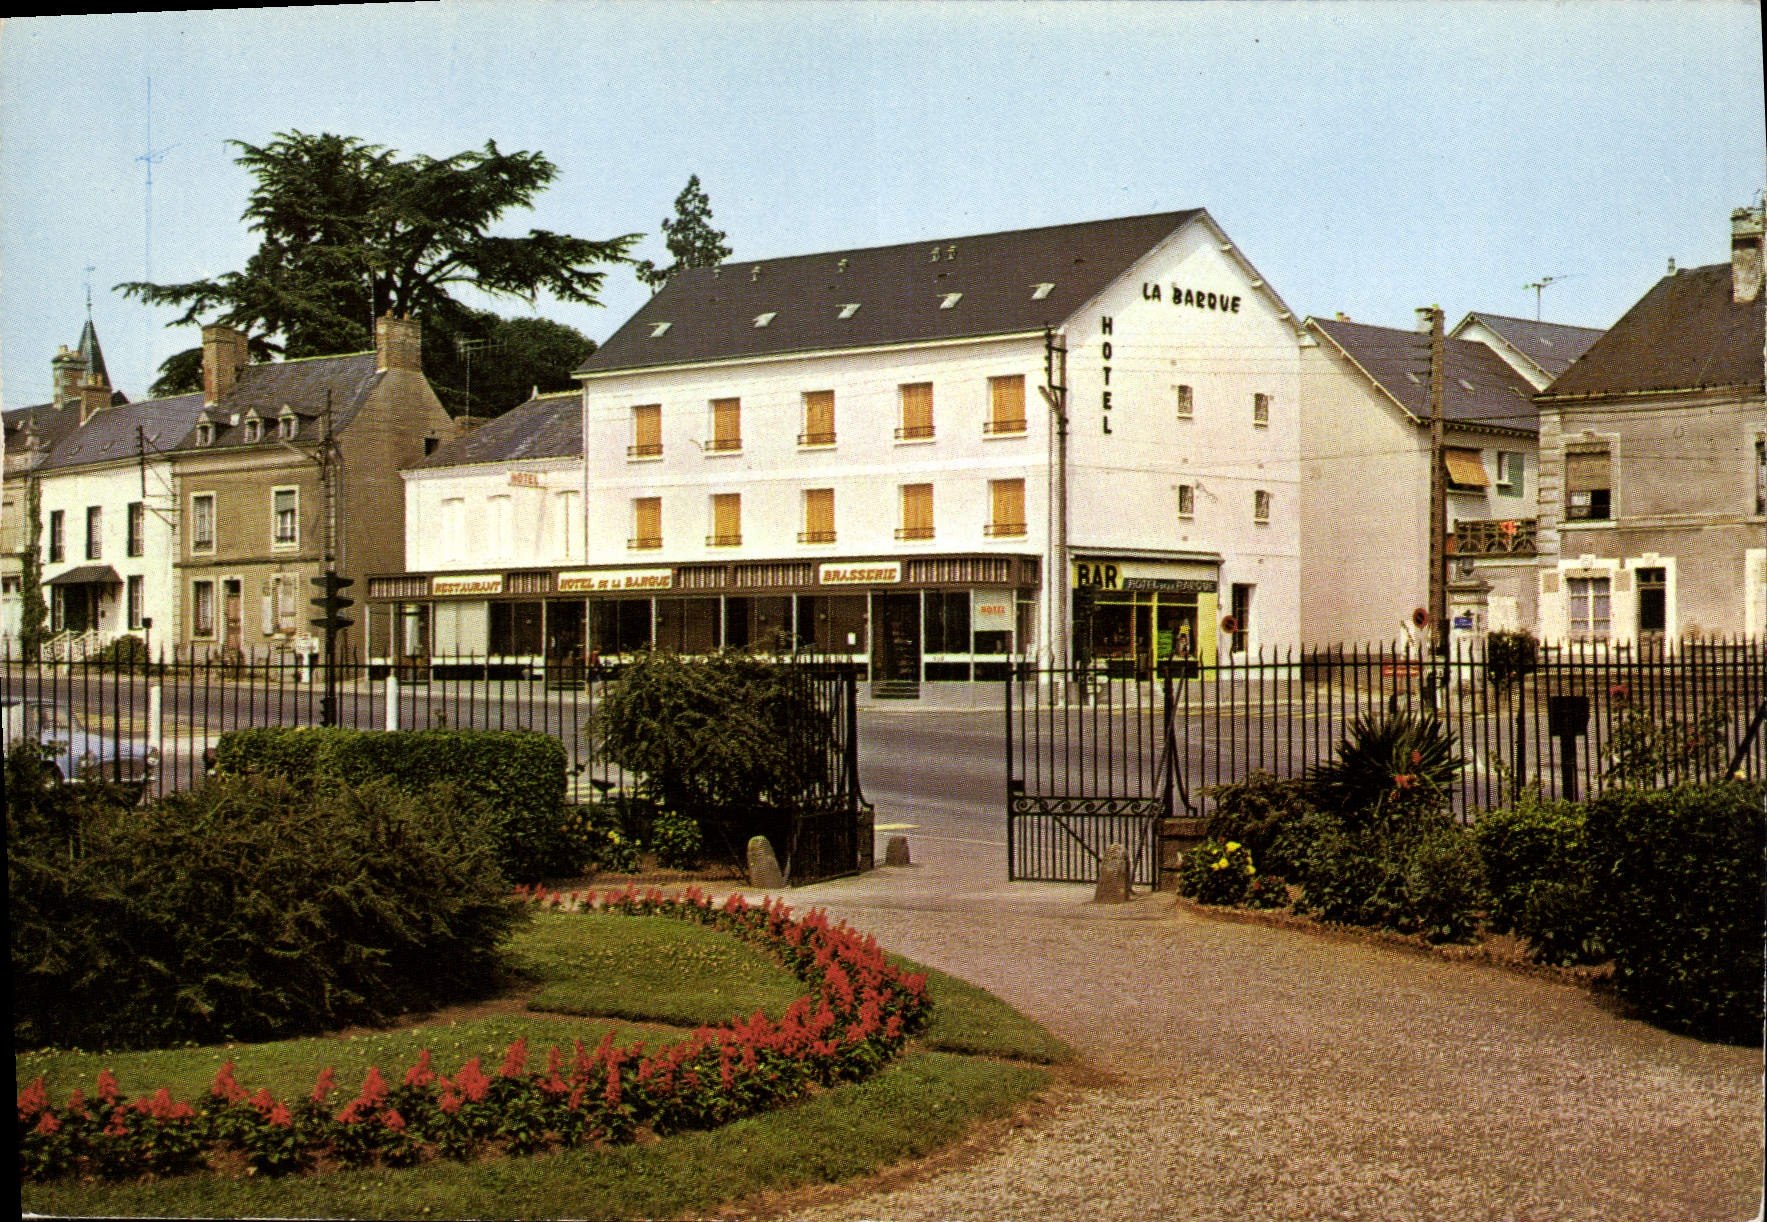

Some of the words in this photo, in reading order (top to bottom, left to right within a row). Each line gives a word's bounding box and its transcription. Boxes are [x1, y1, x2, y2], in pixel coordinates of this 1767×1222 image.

[1142, 282, 1162, 302] LA
[1171, 286, 1241, 314] BARQUE
[1102, 316, 1113, 435] HOTEL
[559, 577, 594, 590] HOTEL
[624, 574, 671, 588] BARQUE
[823, 567, 897, 582] BRASSERIE
[1077, 564, 1118, 588] BAR
[435, 581, 501, 594] RESTAURANT
